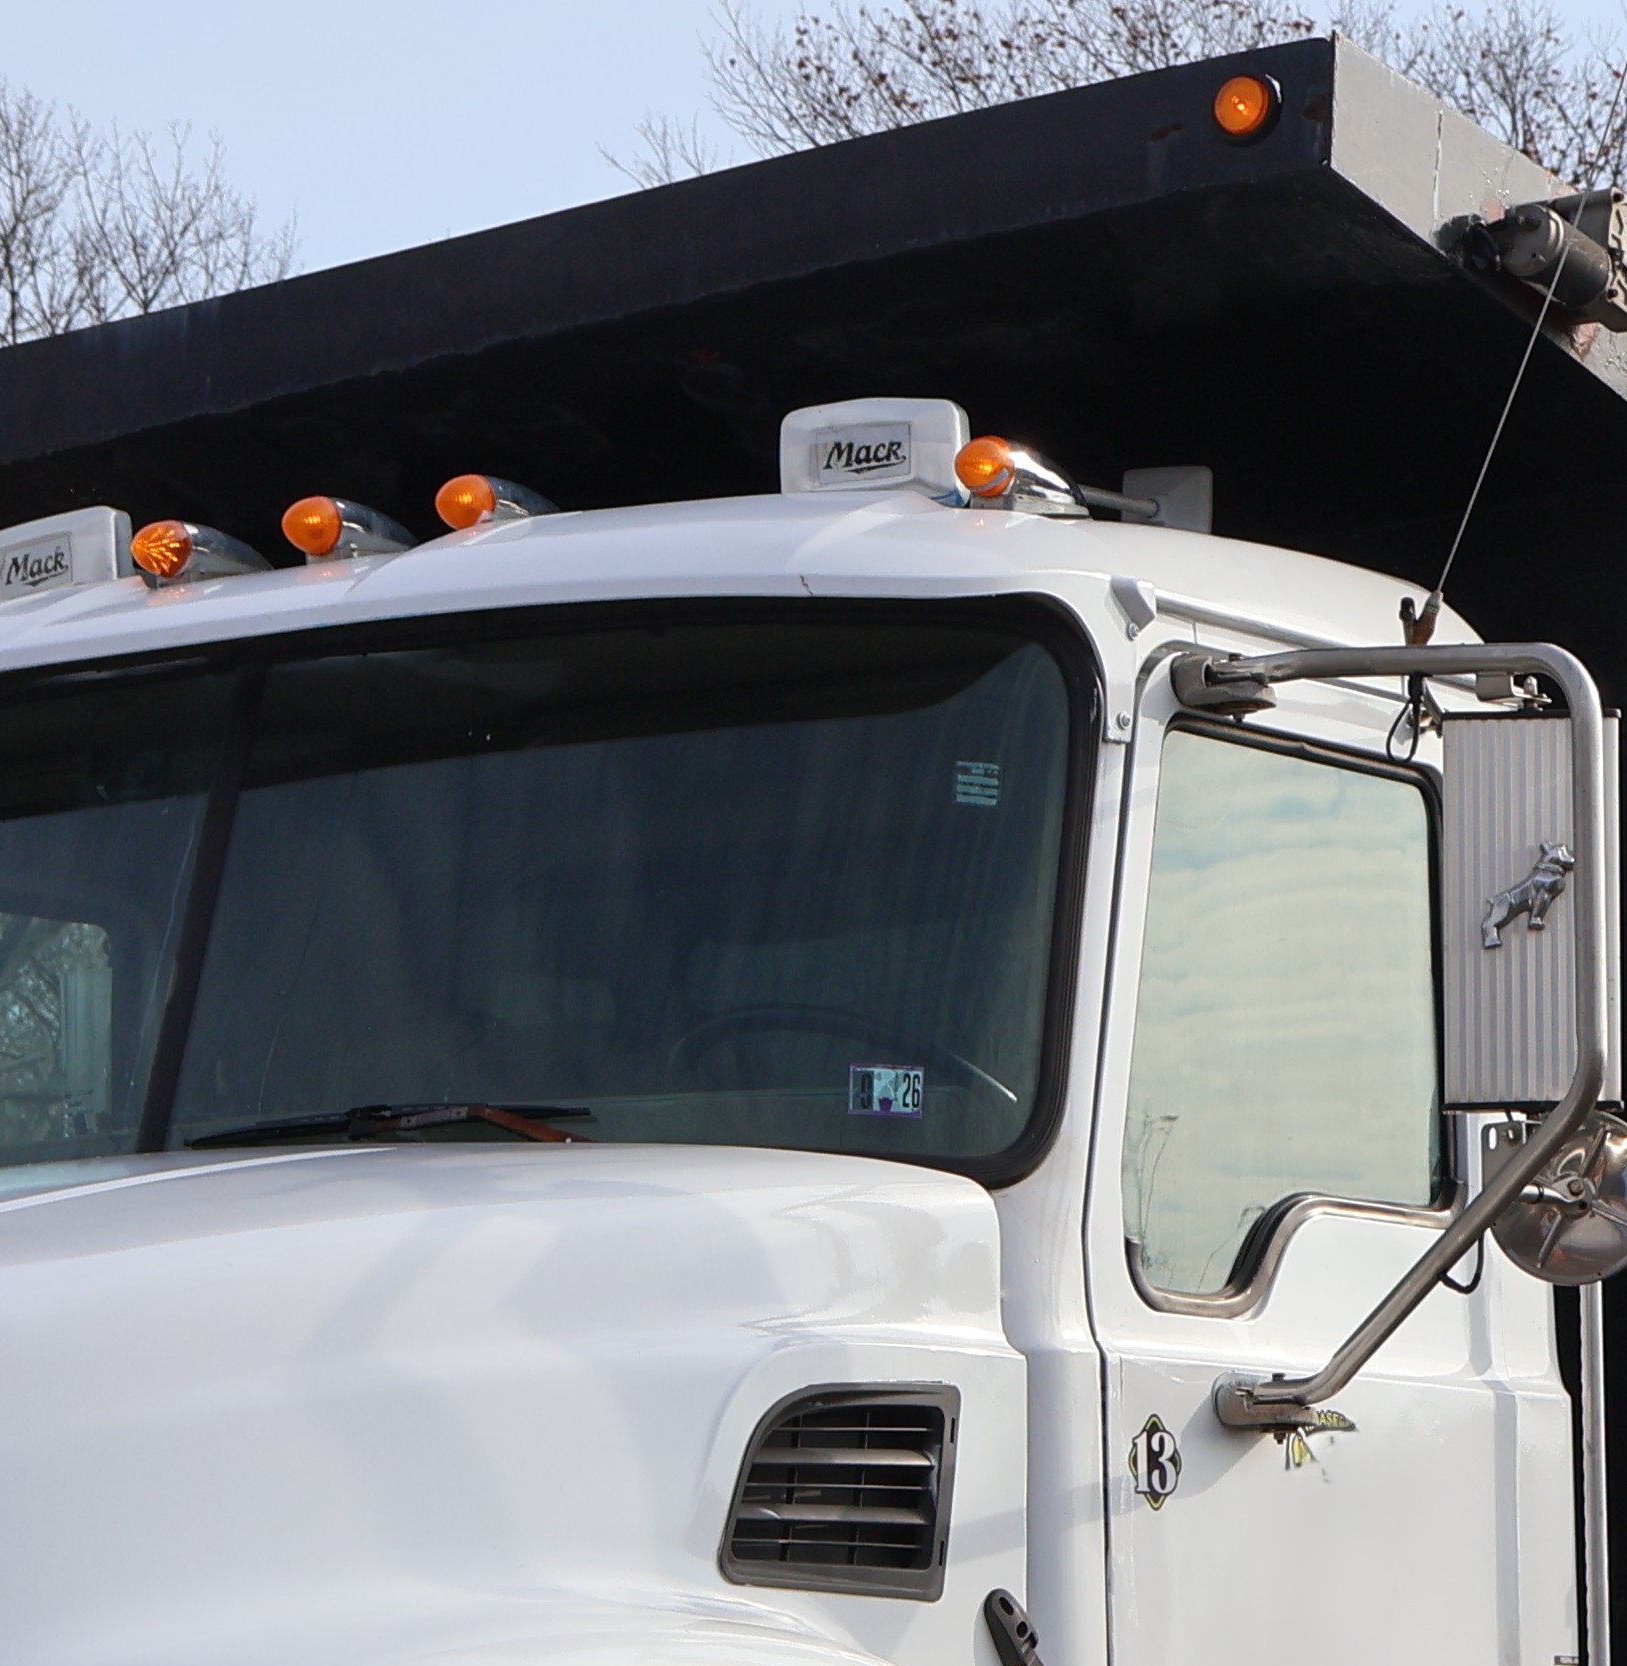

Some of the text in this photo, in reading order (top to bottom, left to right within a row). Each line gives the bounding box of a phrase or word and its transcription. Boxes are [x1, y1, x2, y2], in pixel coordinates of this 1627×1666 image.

[822, 441, 907, 474] Mack
[4, 547, 70, 587] Mack
[902, 1072, 921, 1109] 26
[1133, 1430, 1178, 1495] 13
